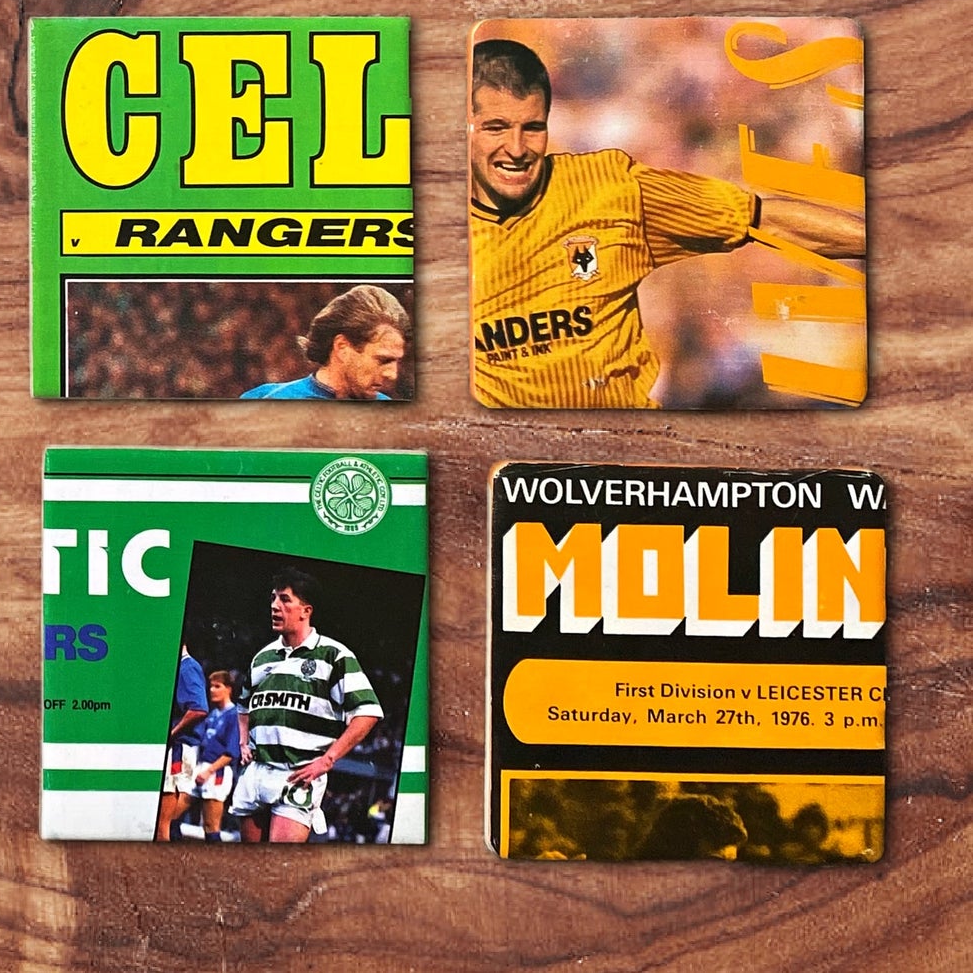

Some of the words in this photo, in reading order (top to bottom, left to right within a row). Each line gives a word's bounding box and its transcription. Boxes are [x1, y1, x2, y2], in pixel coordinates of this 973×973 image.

[62, 29, 411, 189] CEL
[486, 349, 518, 363] PAINT
[521, 347, 529, 358] &
[531, 343, 552, 356] INK
[502, 476, 822, 509] WOLVERHAMPTON
[847, 483, 886, 510] W
[502, 522, 887, 639] MOLIN
[44, 623, 109, 662] RS
[43, 699, 66, 710] OFF
[72, 699, 111, 712] 2.00pm
[615, 682, 655, 698] First
[661, 683, 735, 700] Division
[741, 689, 751, 699] v
[758, 685, 863, 701] LEICESTER
[548, 706, 637, 725] Saturday,
[647, 708, 706, 724] March
[824, 712, 834, 726] 3
[843, 714, 883, 729] p.m.
